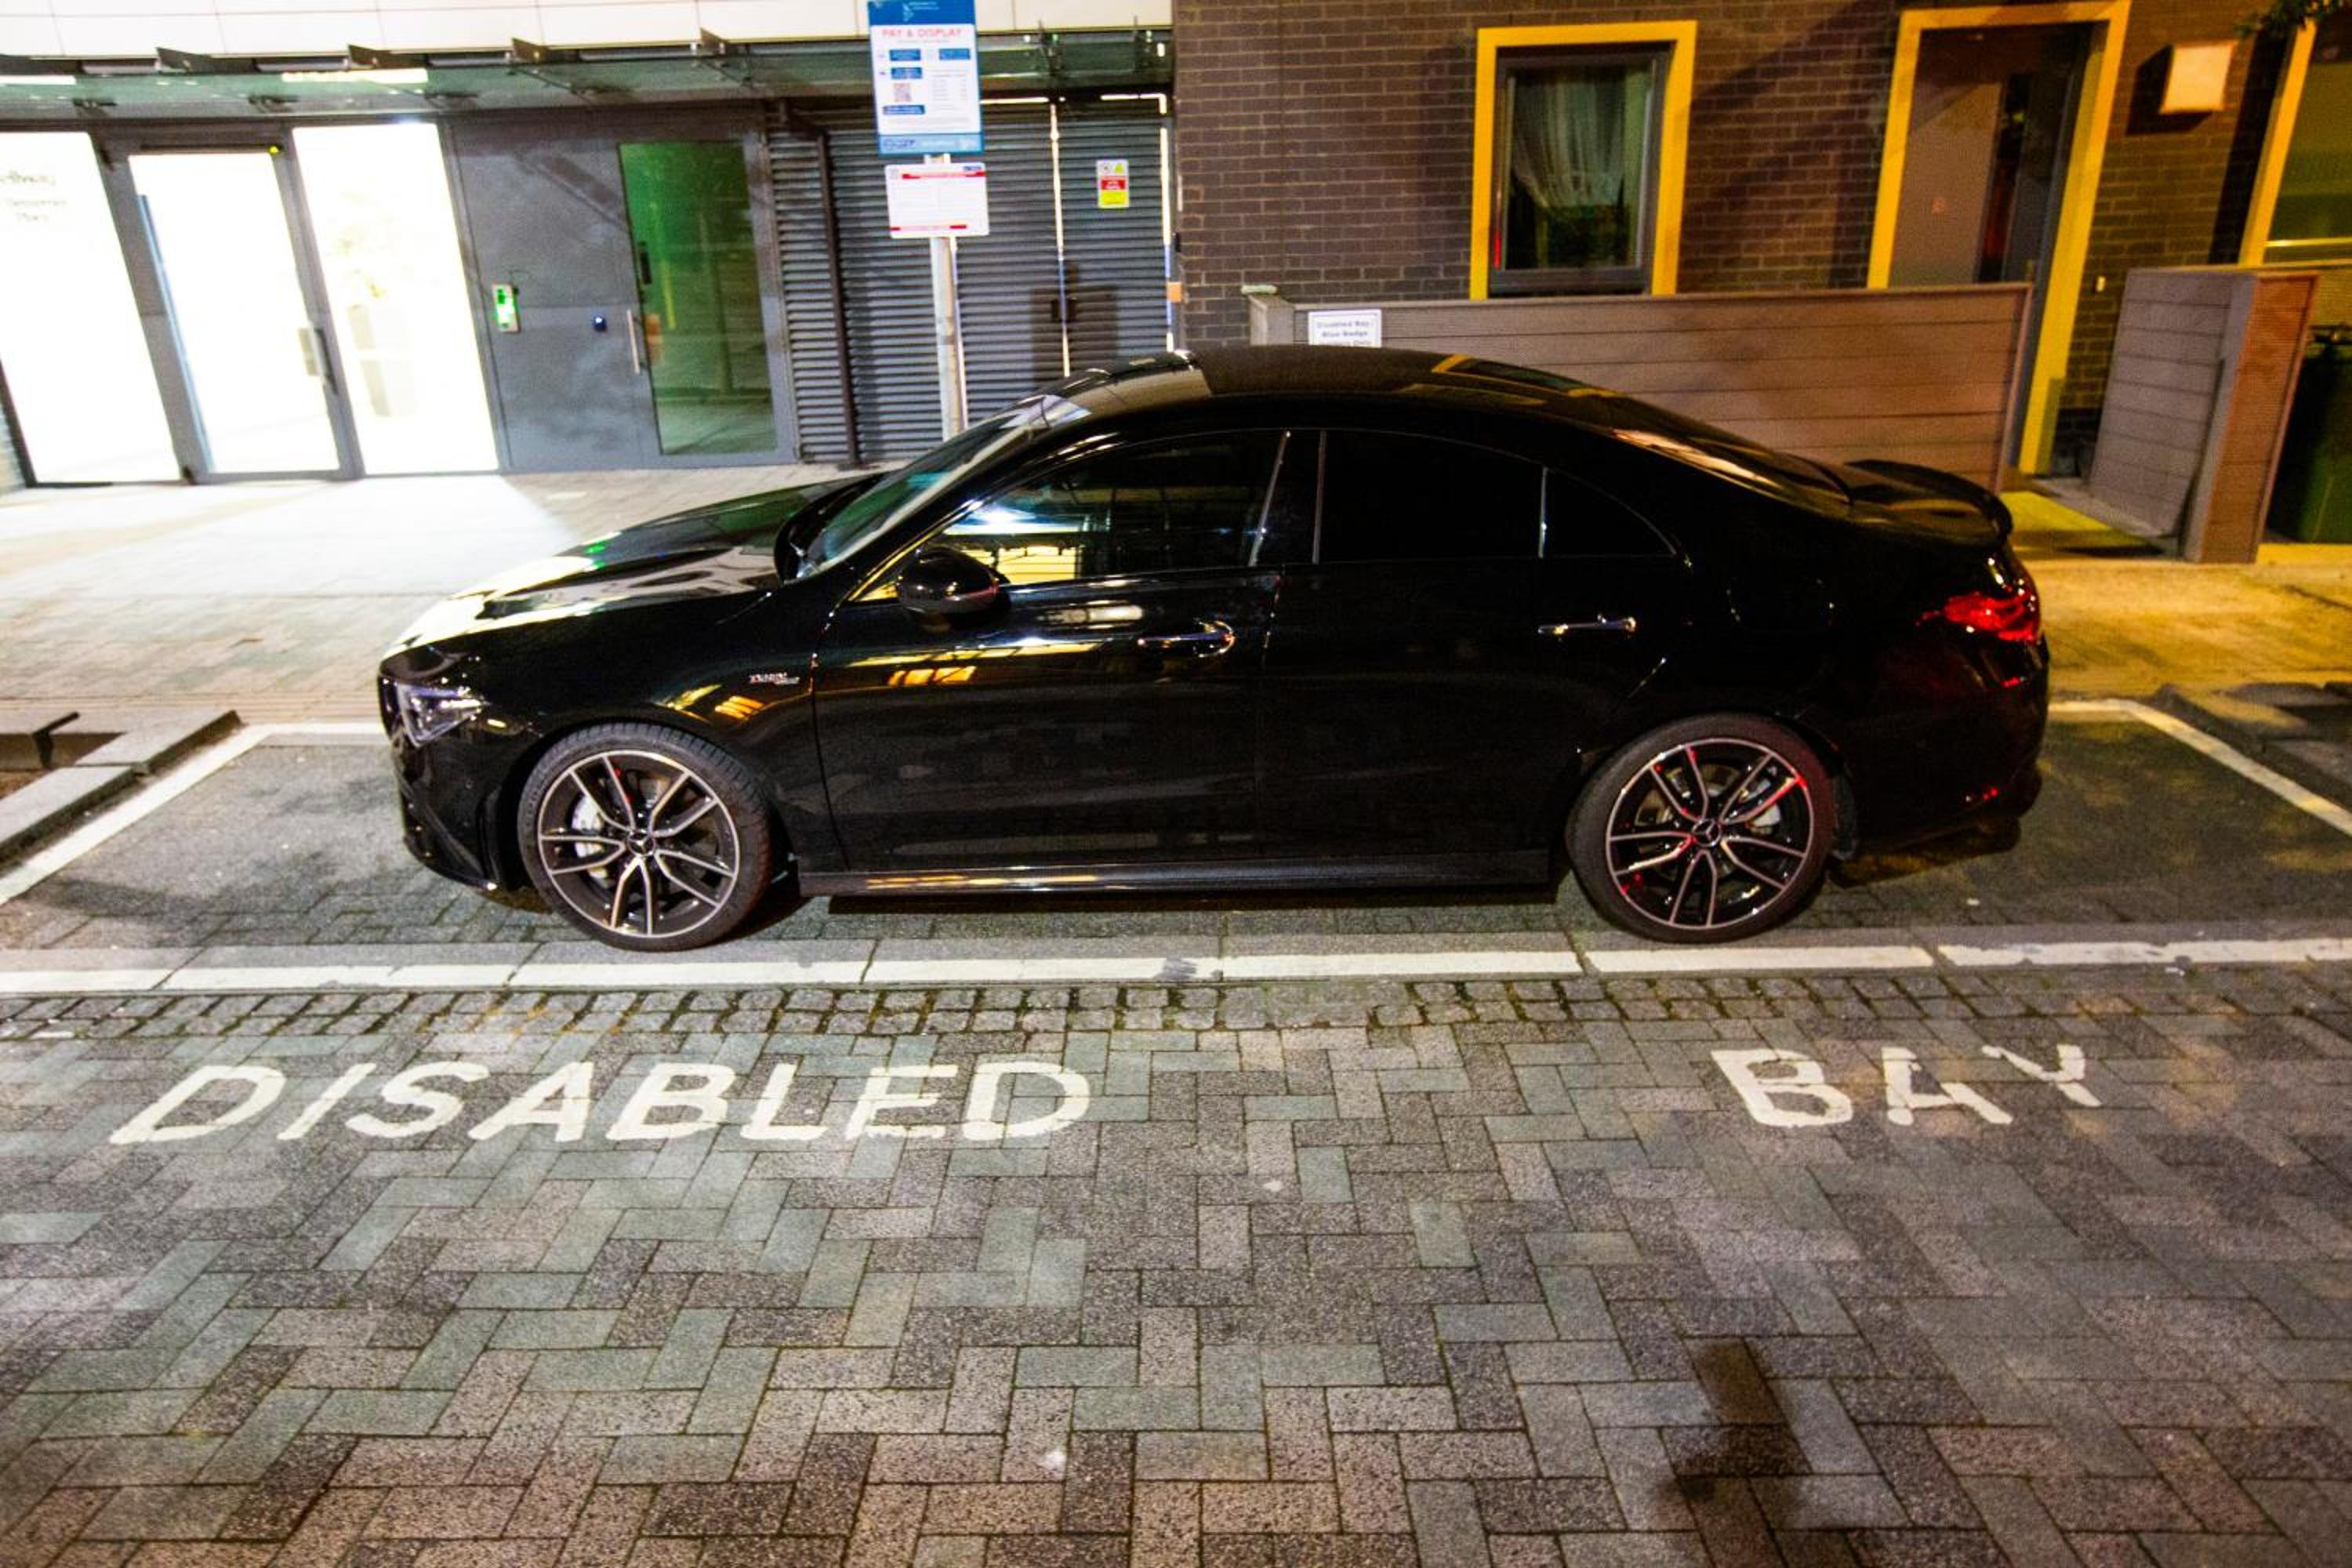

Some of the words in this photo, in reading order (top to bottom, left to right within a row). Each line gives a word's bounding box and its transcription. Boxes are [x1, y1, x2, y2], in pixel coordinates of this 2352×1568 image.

[917, 28, 961, 37] DISPLAY
[110, 1060, 1091, 1145] DISABLED
[1711, 1044, 2103, 1127] BAY
